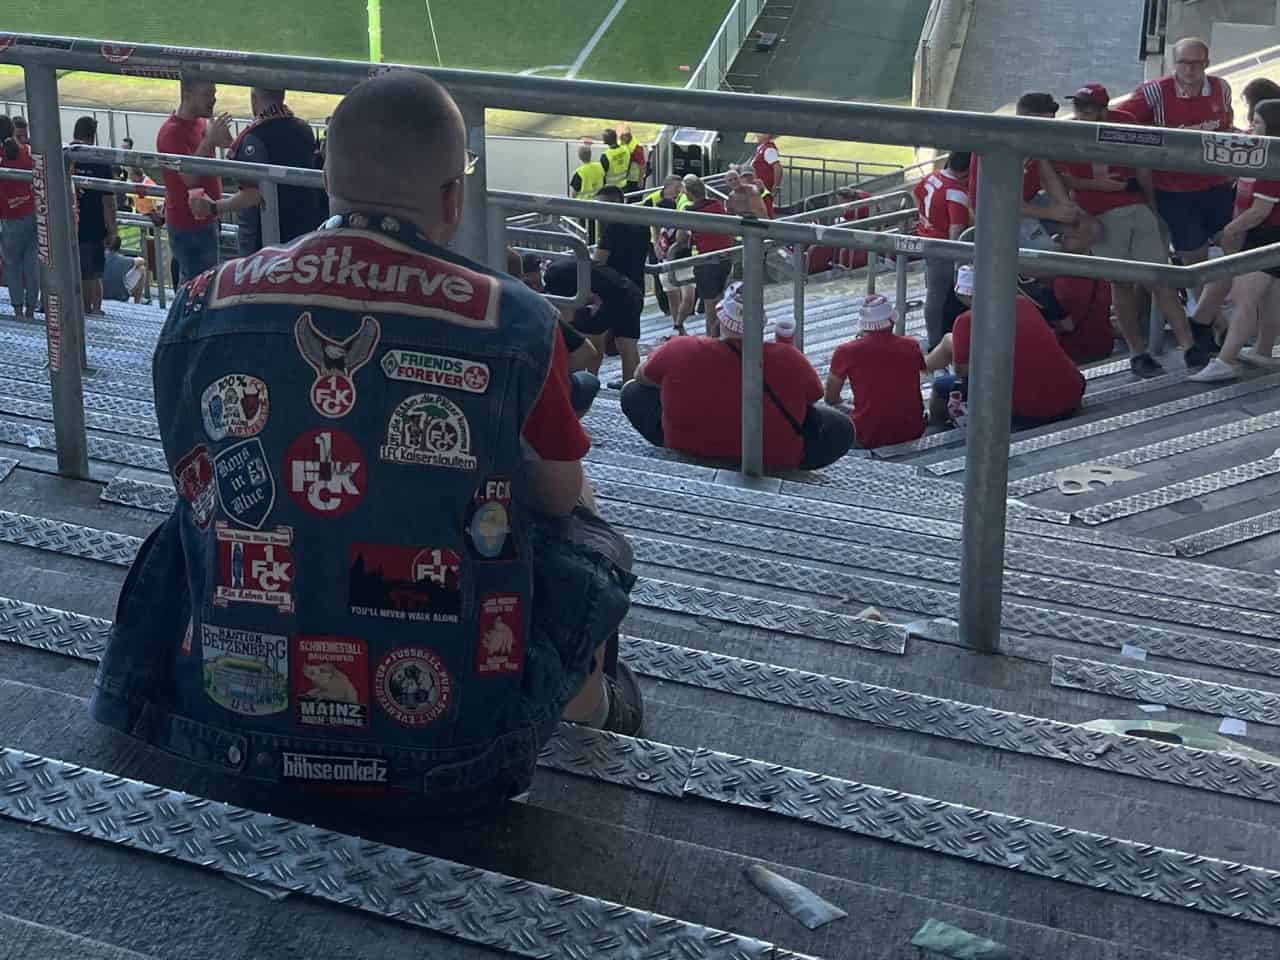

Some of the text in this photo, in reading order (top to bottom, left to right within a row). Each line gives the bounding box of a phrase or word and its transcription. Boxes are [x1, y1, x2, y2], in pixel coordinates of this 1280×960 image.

[1205, 141, 1265, 166] 1900
[400, 353, 463, 373] FRIENDS
[397, 366, 464, 387] FOREVER
[217, 447, 251, 478] Boys
[231, 488, 265, 514] Blue
[380, 608, 406, 620] NEVER
[408, 611, 431, 622] WALK
[433, 613, 460, 624] ALONE
[202, 626, 287, 660] BETZENBERG
[301, 701, 362, 718] MAINZ
